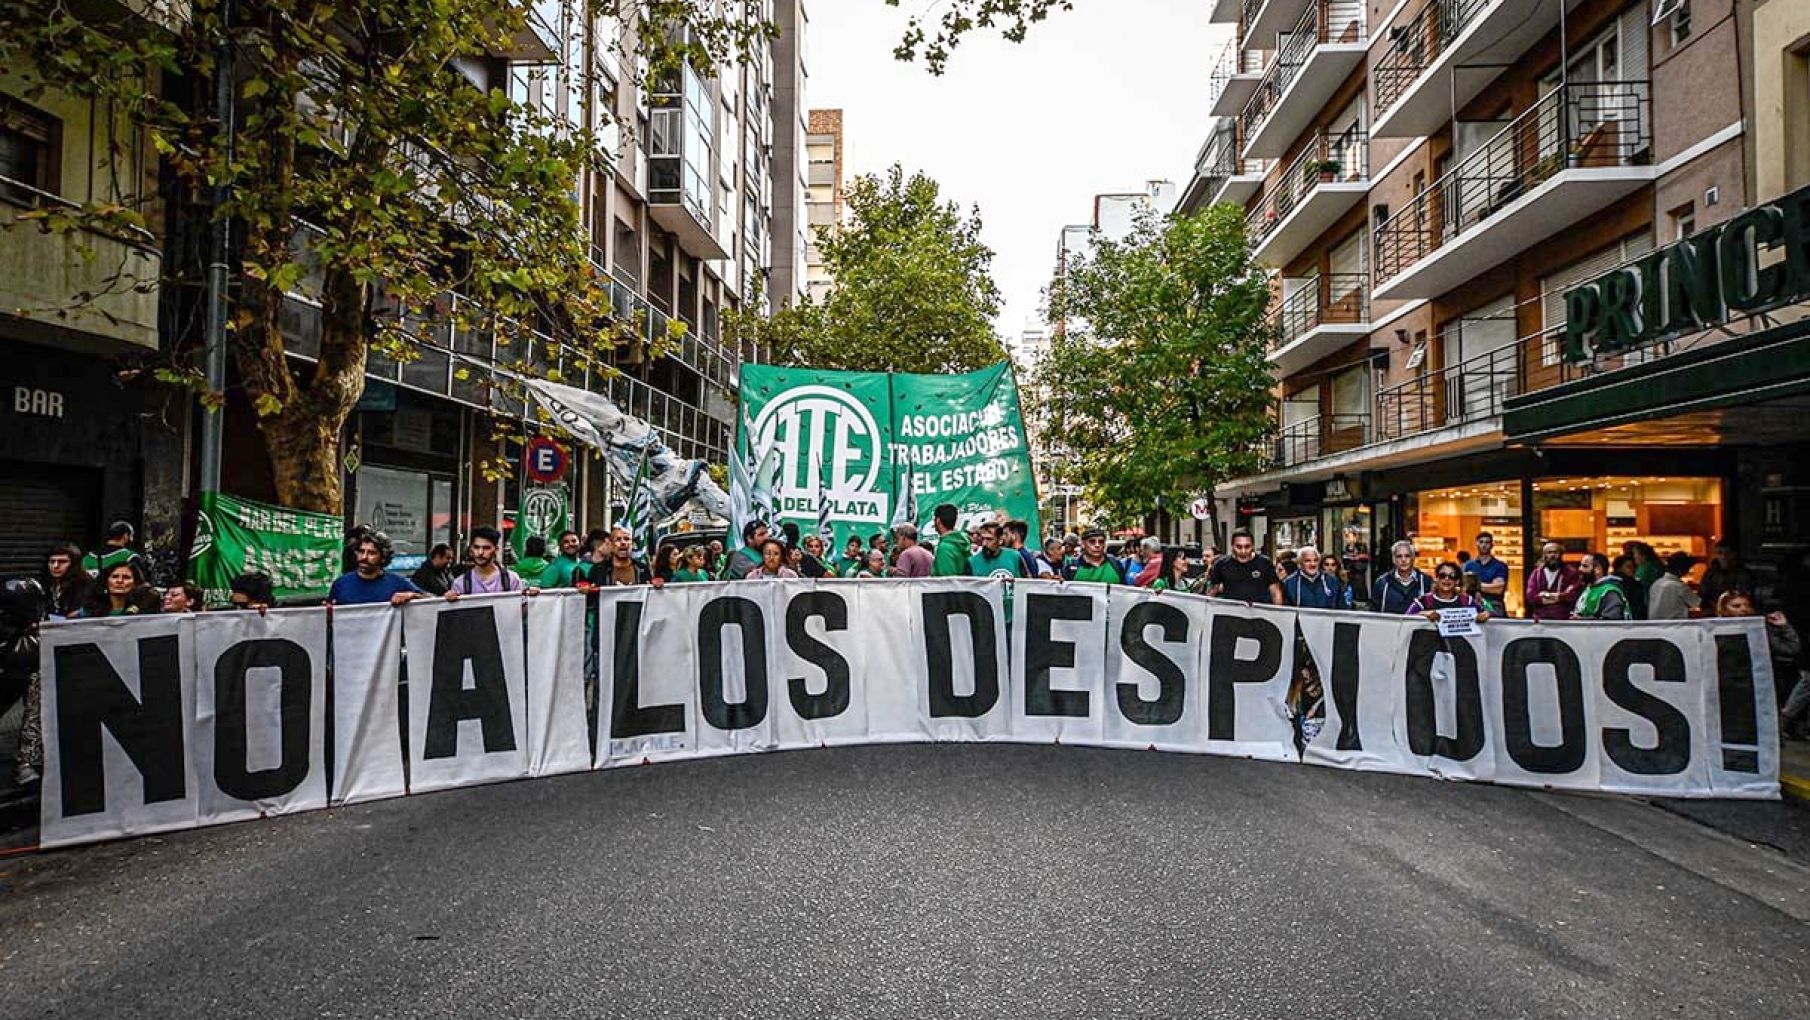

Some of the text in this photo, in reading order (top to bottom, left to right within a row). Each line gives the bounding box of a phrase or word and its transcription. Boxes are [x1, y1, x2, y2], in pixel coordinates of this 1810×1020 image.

[14, 387, 64, 418] BAR
[538, 449, 554, 471] E
[757, 399, 868, 494] ATE
[887, 426, 1019, 466] TRABAJADORES
[784, 497, 818, 511] DEL
[54, 590, 1760, 817] NO A LOS DESPIDOS!
